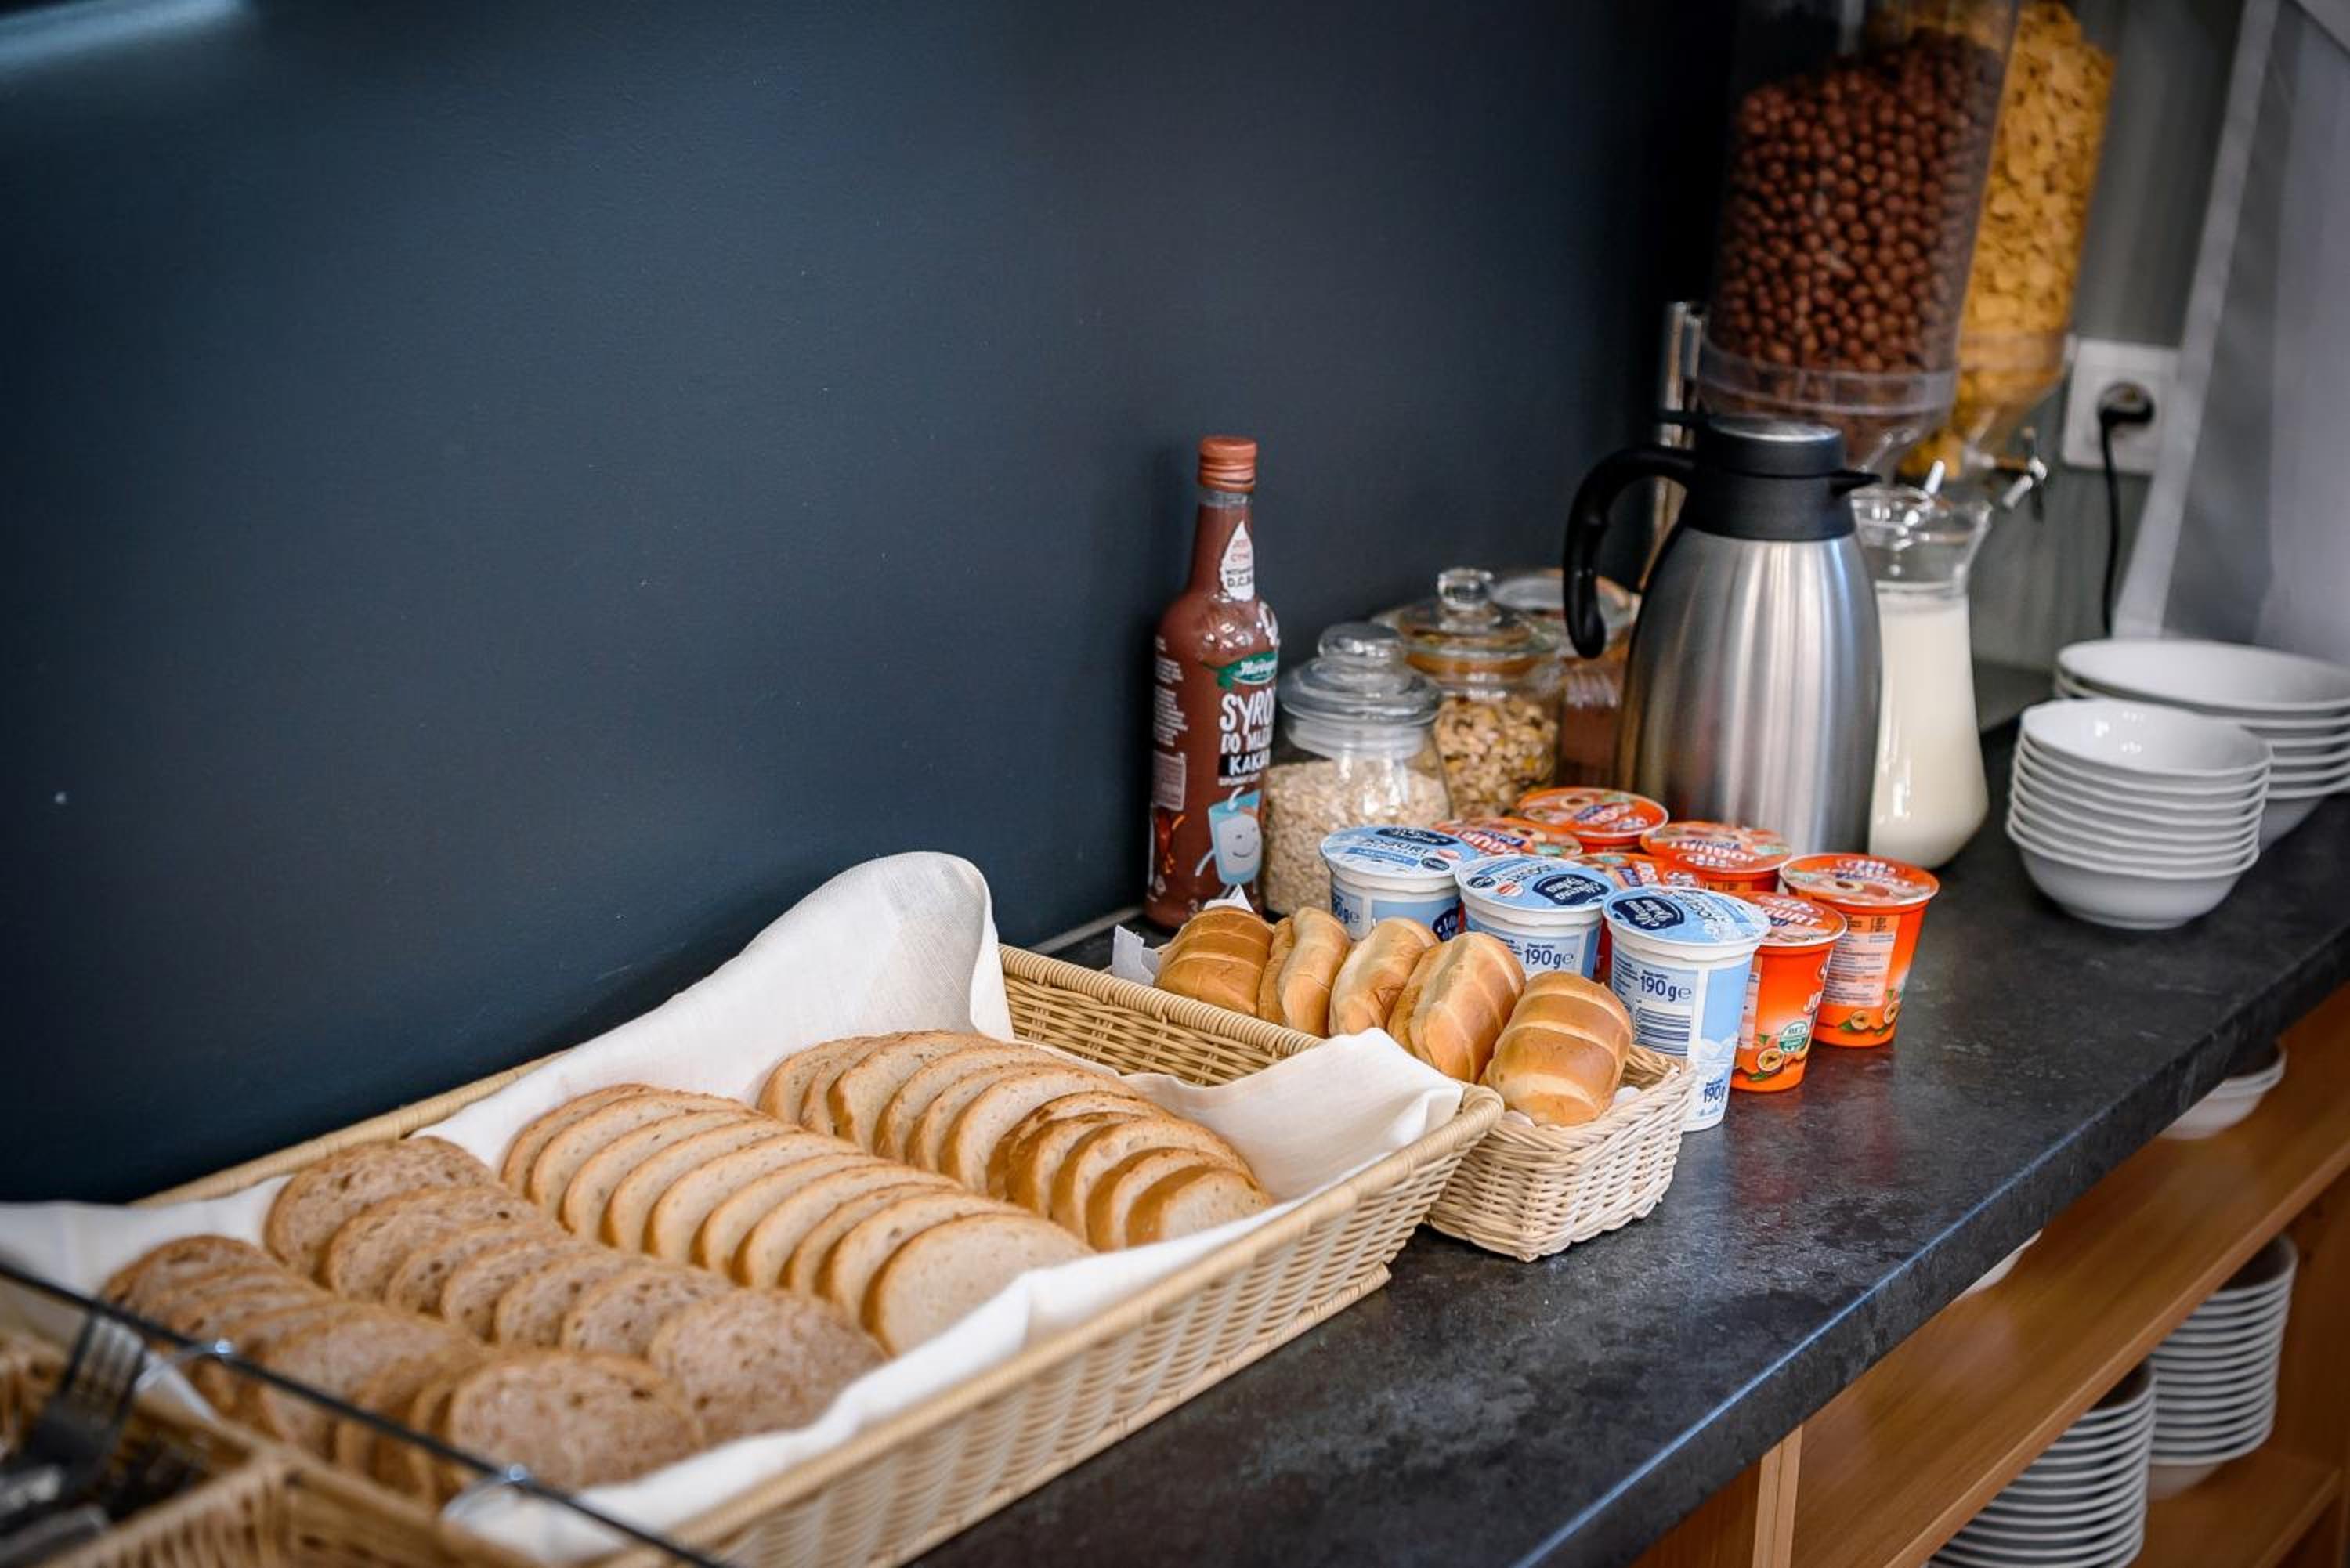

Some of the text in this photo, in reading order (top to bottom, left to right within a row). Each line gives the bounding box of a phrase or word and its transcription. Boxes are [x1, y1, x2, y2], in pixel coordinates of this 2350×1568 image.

[1220, 733, 1241, 754] DO
[1524, 948, 1552, 965] 190
[1640, 976, 1665, 996] 190
